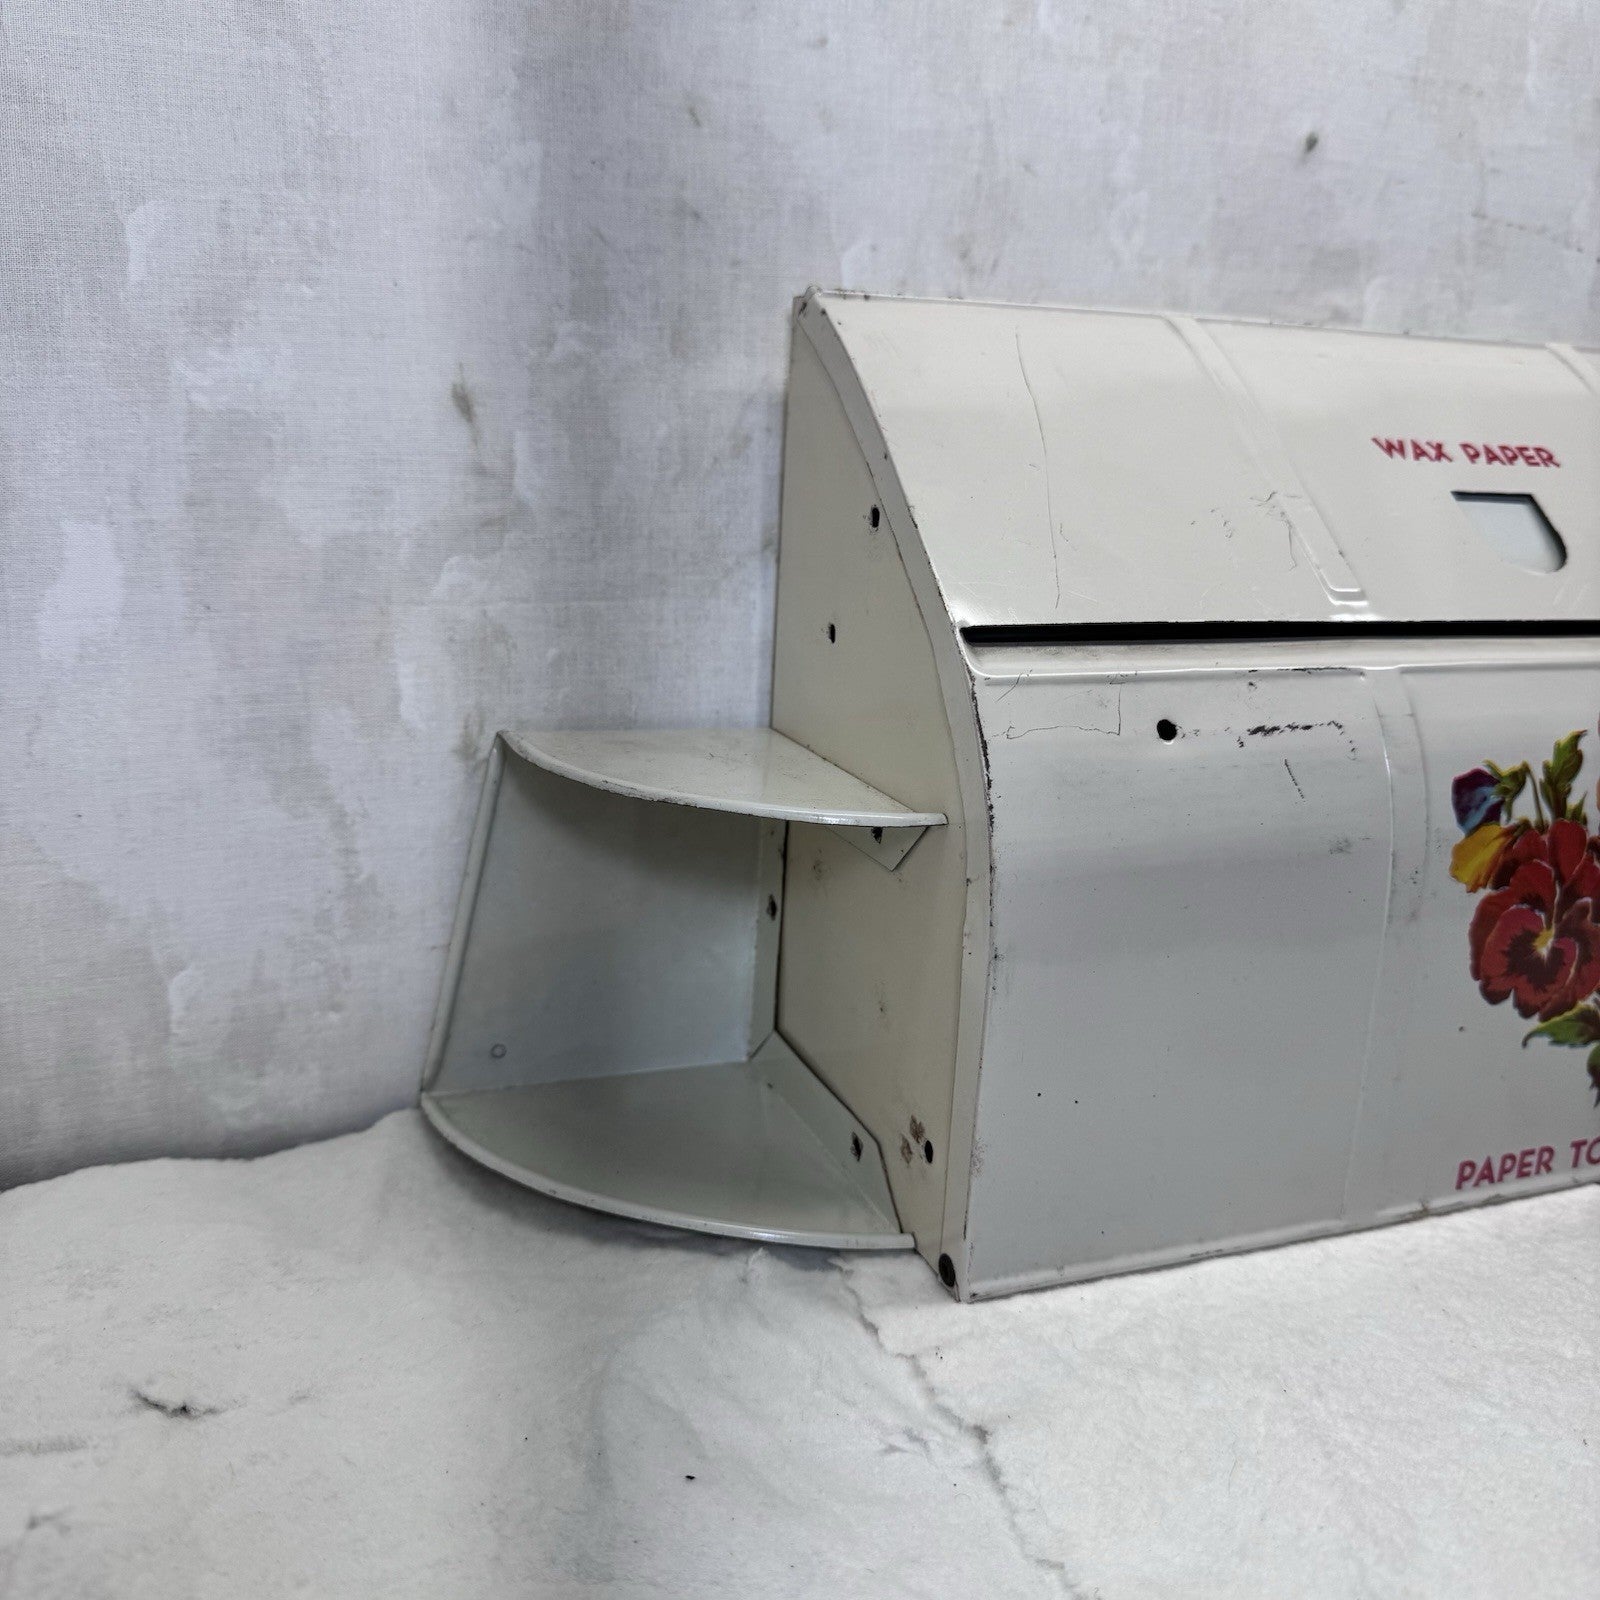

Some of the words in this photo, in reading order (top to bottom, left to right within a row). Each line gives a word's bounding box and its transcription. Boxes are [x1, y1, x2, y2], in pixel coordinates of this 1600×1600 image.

[1371, 436, 1453, 462] WAX
[1459, 442, 1561, 468] PAPER
[1455, 1145, 1555, 1190] PAPER
